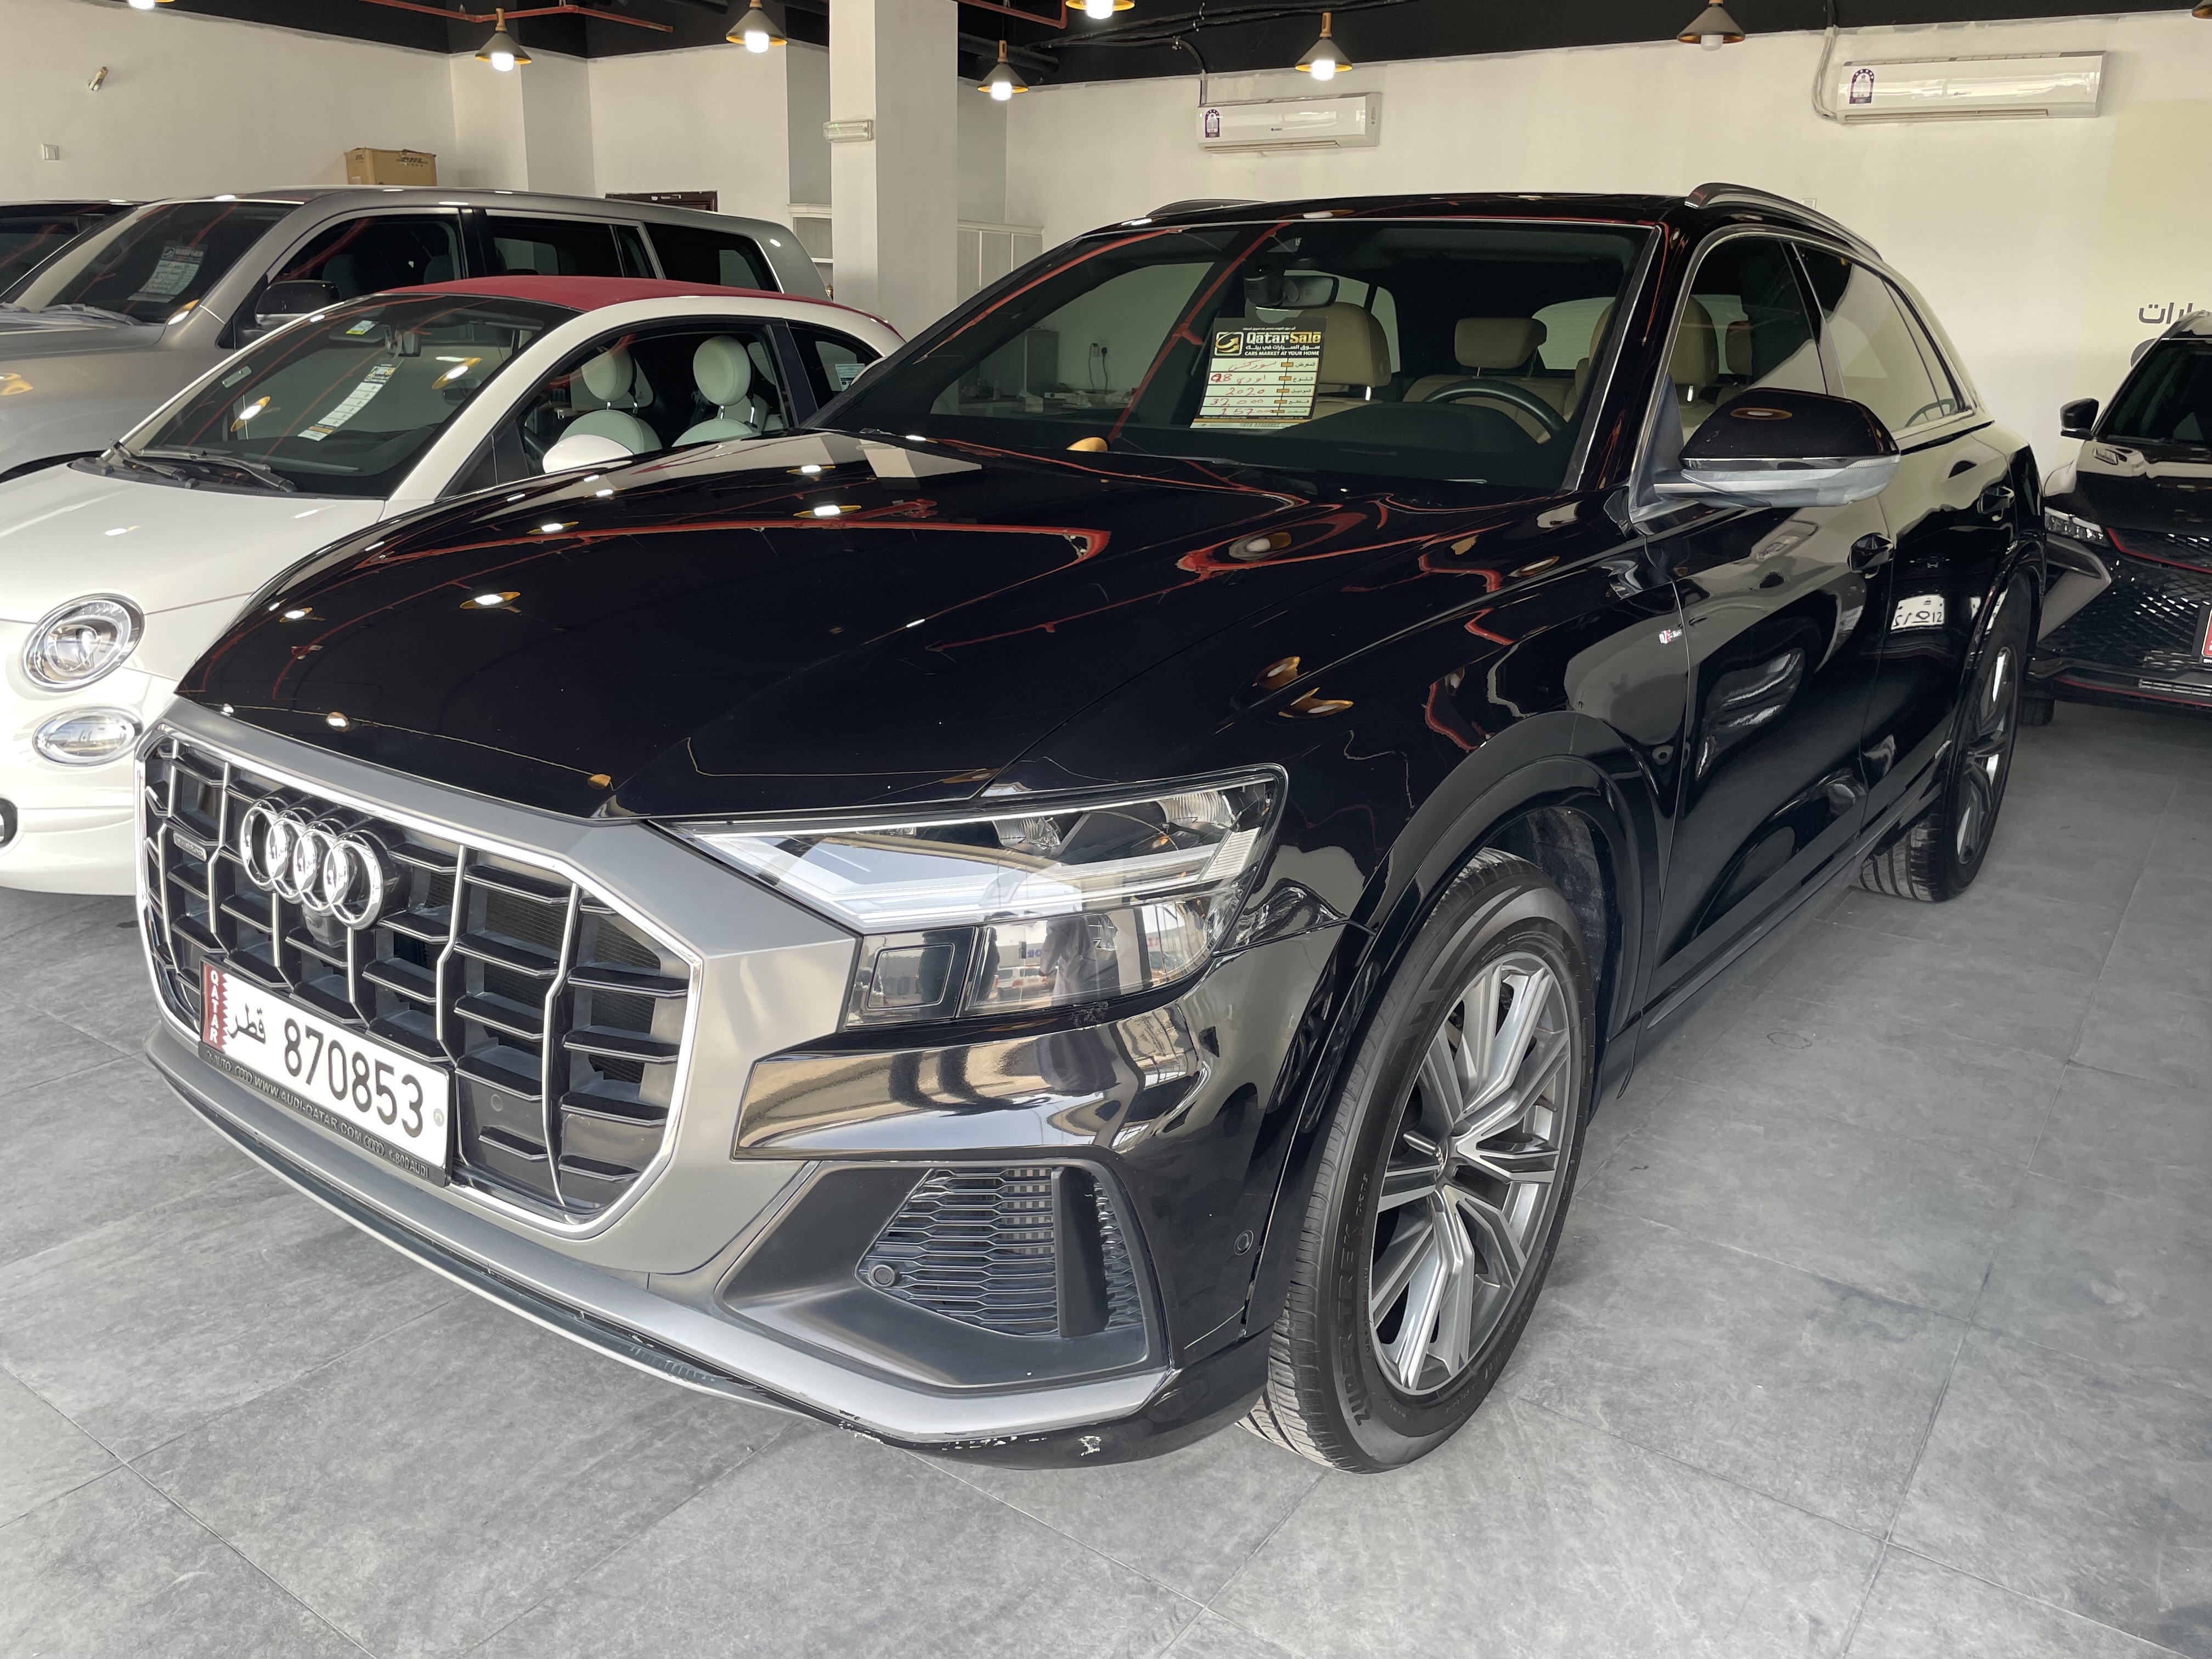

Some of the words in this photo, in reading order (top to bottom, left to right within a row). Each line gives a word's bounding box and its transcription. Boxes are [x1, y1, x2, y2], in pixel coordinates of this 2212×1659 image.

[1246, 331, 1322, 345] QatarSale
[1226, 387, 1265, 396] 2020
[210, 969, 219, 1044] QATAR
[227, 1002, 266, 1045] قطر
[206, 1050, 232, 1072] Q-AUTO
[254, 1075, 363, 1143] WWW.AUDI-QATAR.COM
[284, 1018, 424, 1138] 870853
